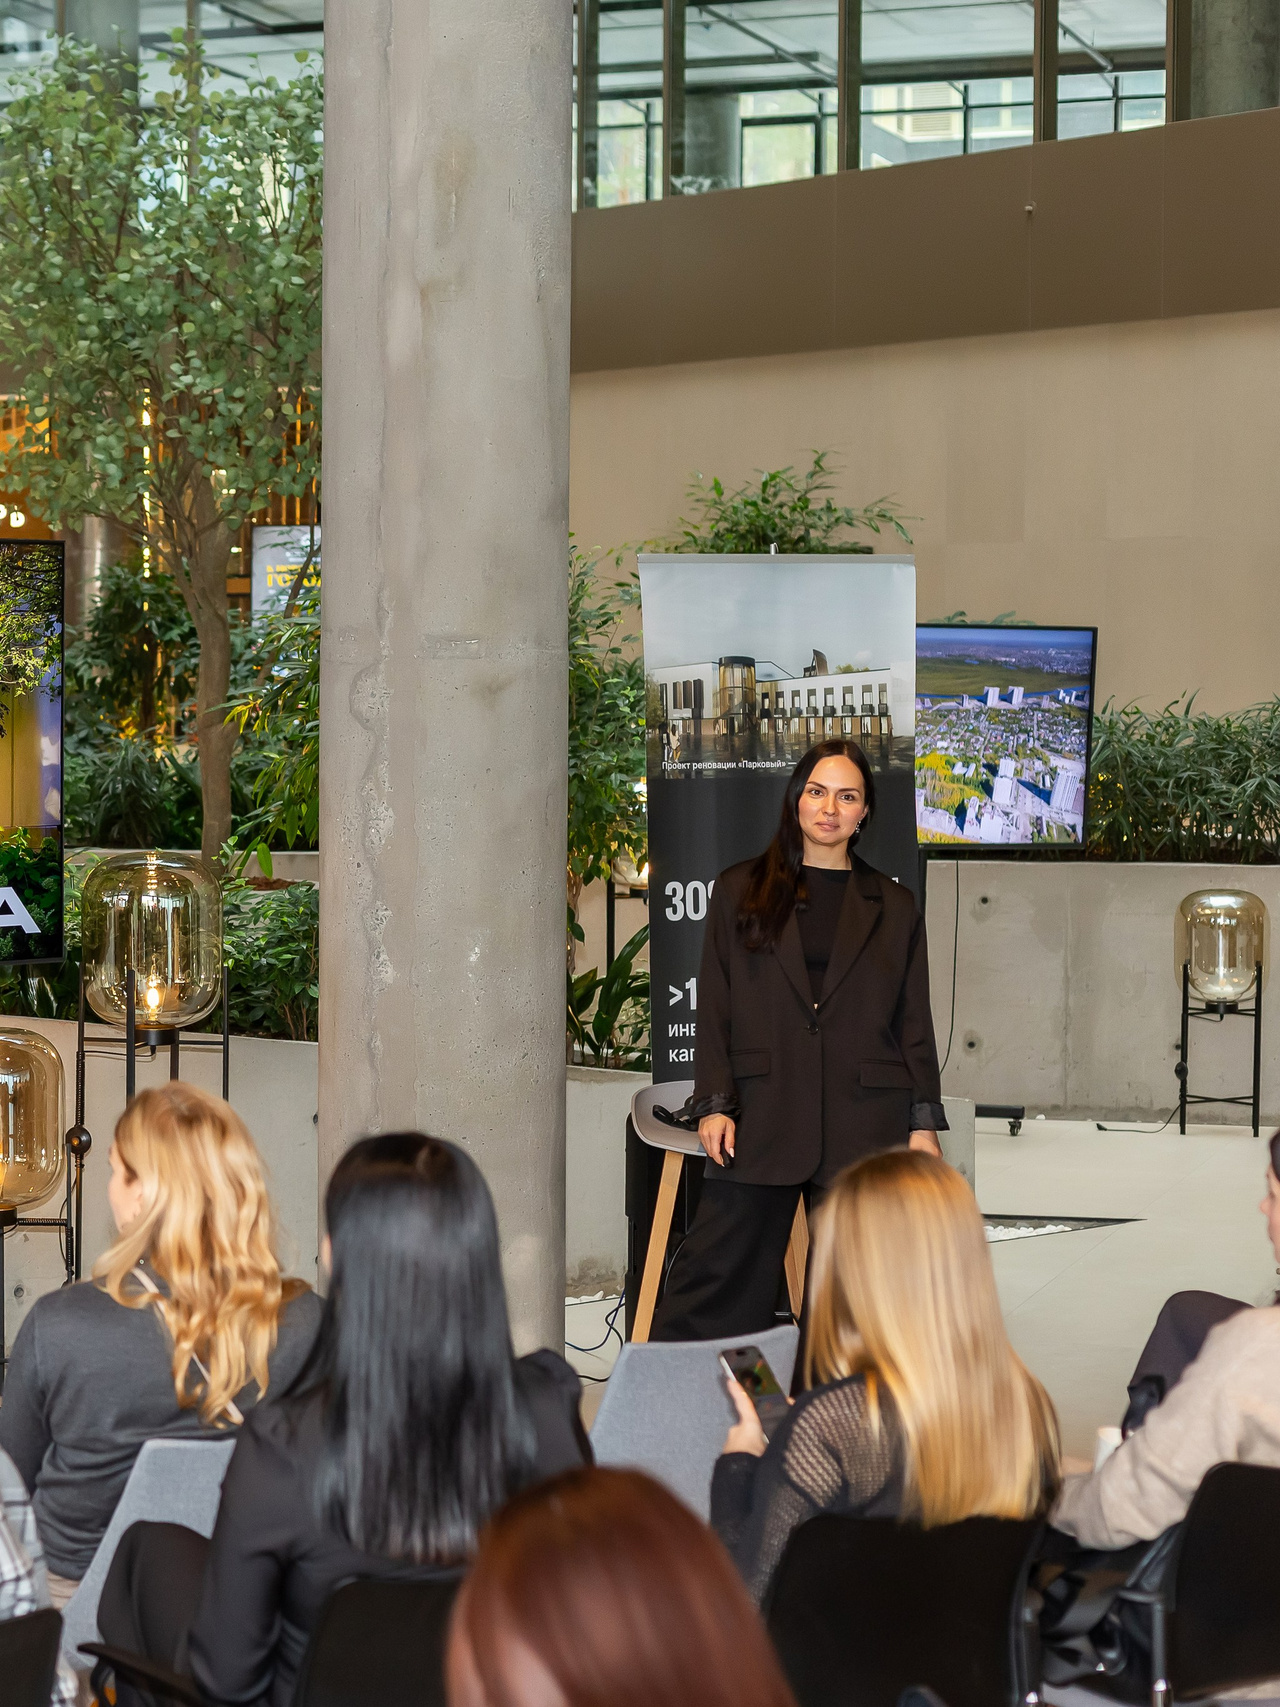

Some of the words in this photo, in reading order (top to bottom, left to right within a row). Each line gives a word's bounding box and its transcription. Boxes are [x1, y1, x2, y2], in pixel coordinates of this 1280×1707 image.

[662, 761, 691, 771] Проект
[692, 761, 737, 771] реновации
[738, 759, 786, 770] «Парковый»
